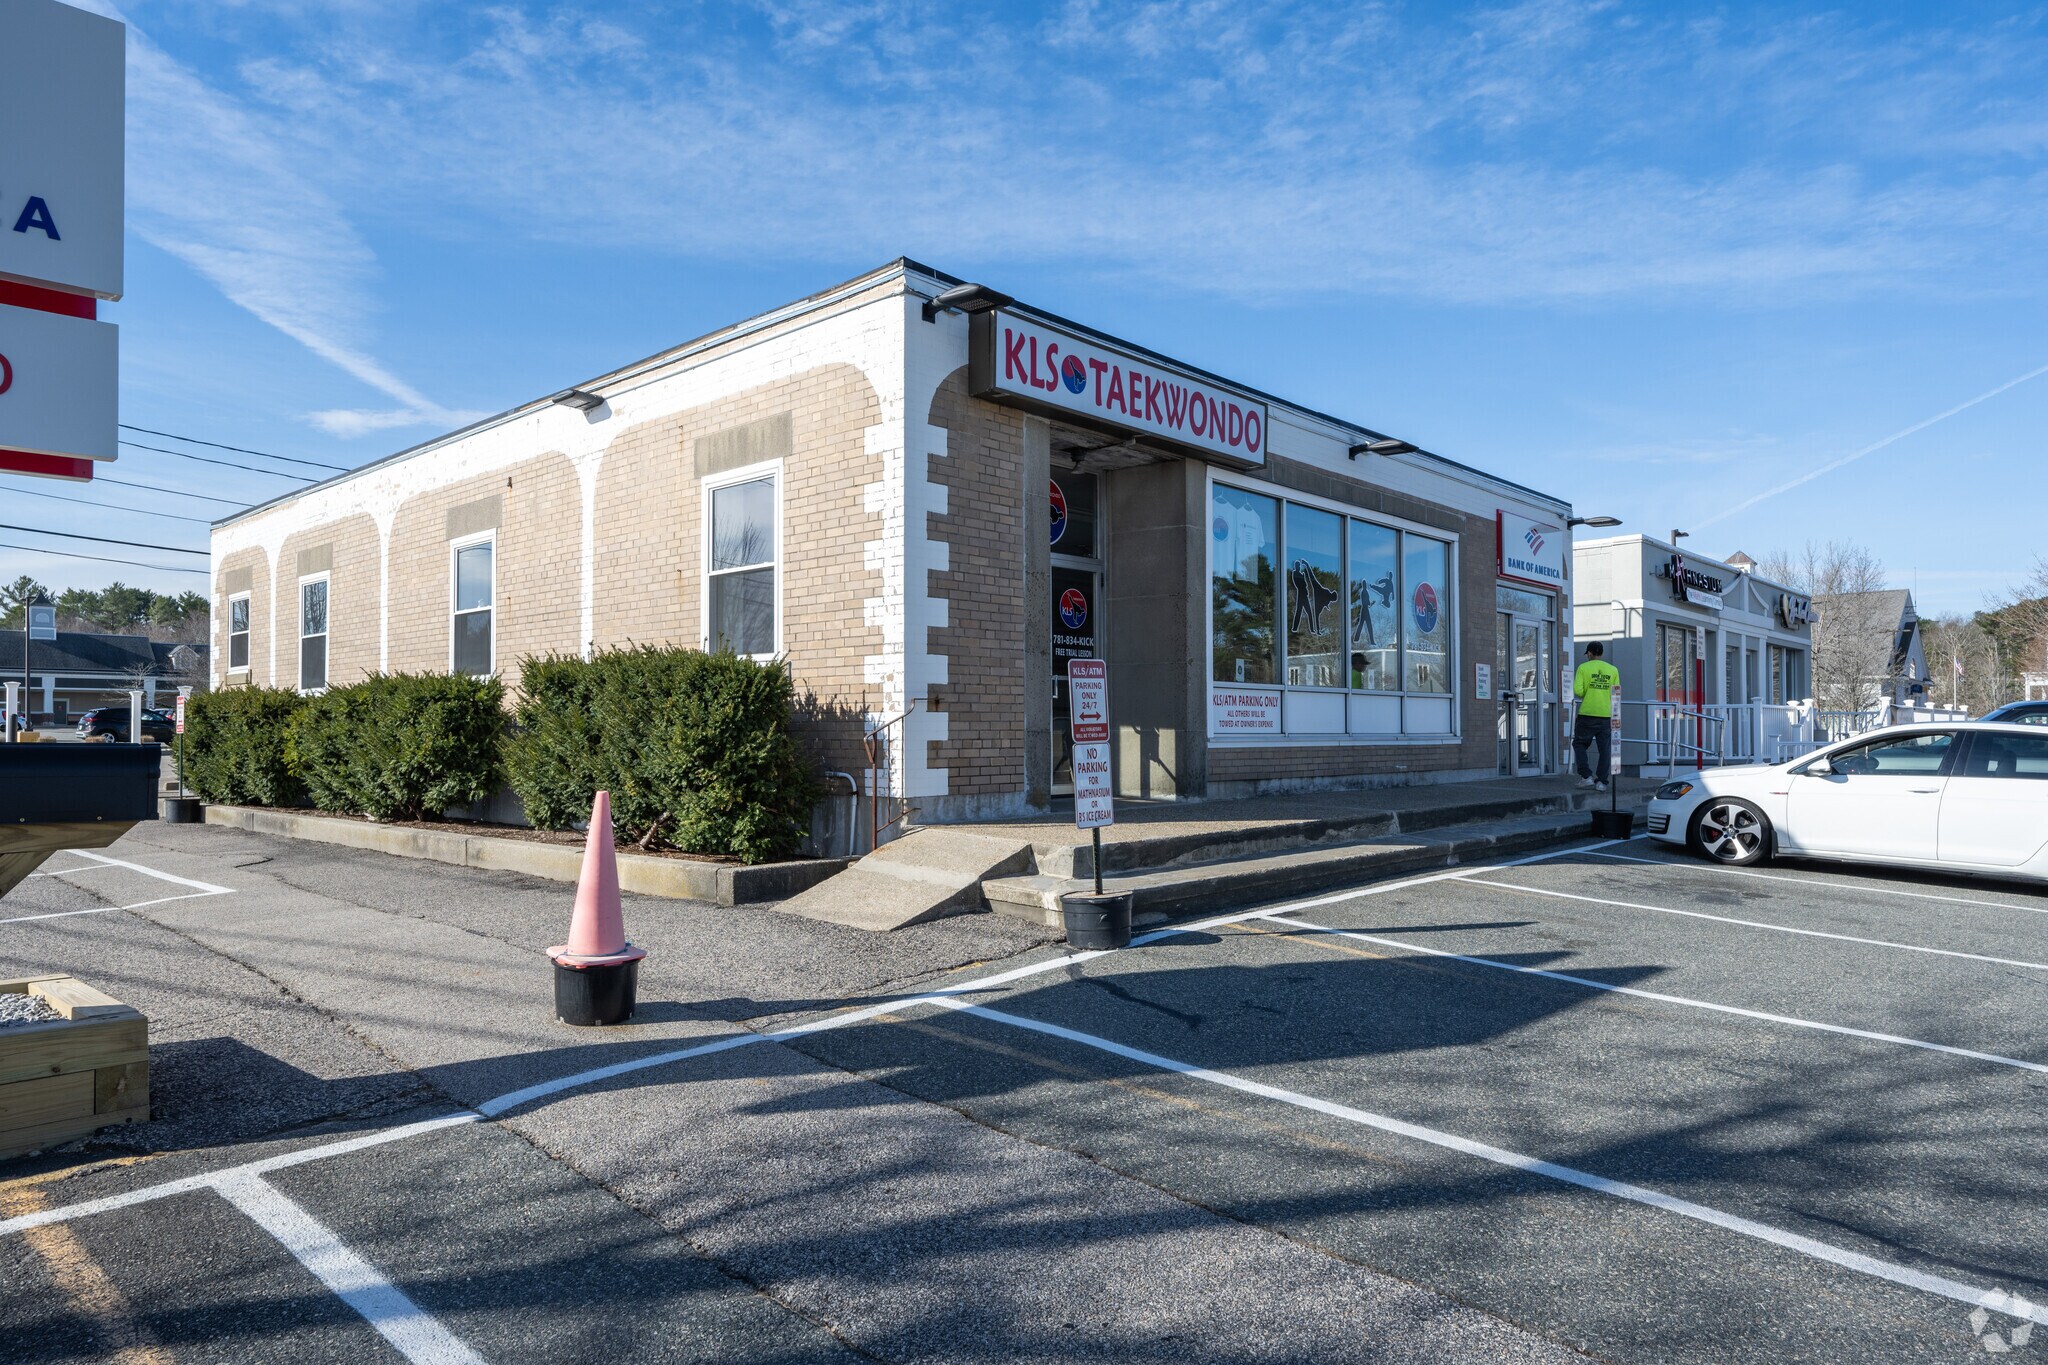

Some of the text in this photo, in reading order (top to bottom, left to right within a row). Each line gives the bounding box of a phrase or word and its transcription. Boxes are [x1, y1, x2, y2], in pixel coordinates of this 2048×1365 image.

[1004, 328, 1261, 453] KLS TAEKWONDO
[1508, 557, 1560, 578] BANK OF AMERICA
[1053, 634, 1094, 646] 781-834-KICK
[1055, 648, 1065, 656] FREE
[1073, 667, 1103, 677] KLS/ATM
[1075, 682, 1102, 690] PARKING
[1082, 692, 1097, 700] ONLY
[1213, 694, 1279, 707] KLS/ATM PARKING ONLY
[1082, 702, 1097, 710] 24/7
[1234, 720, 1240, 728] AT
[1087, 749, 1098, 759] NO
[1078, 761, 1108, 774] PARKING
[1089, 776, 1099, 785] FOR
[1078, 787, 1111, 800] MATHNASIUM
[1091, 800, 1098, 808] OR
[1095, 809, 1112, 822] CREAM
